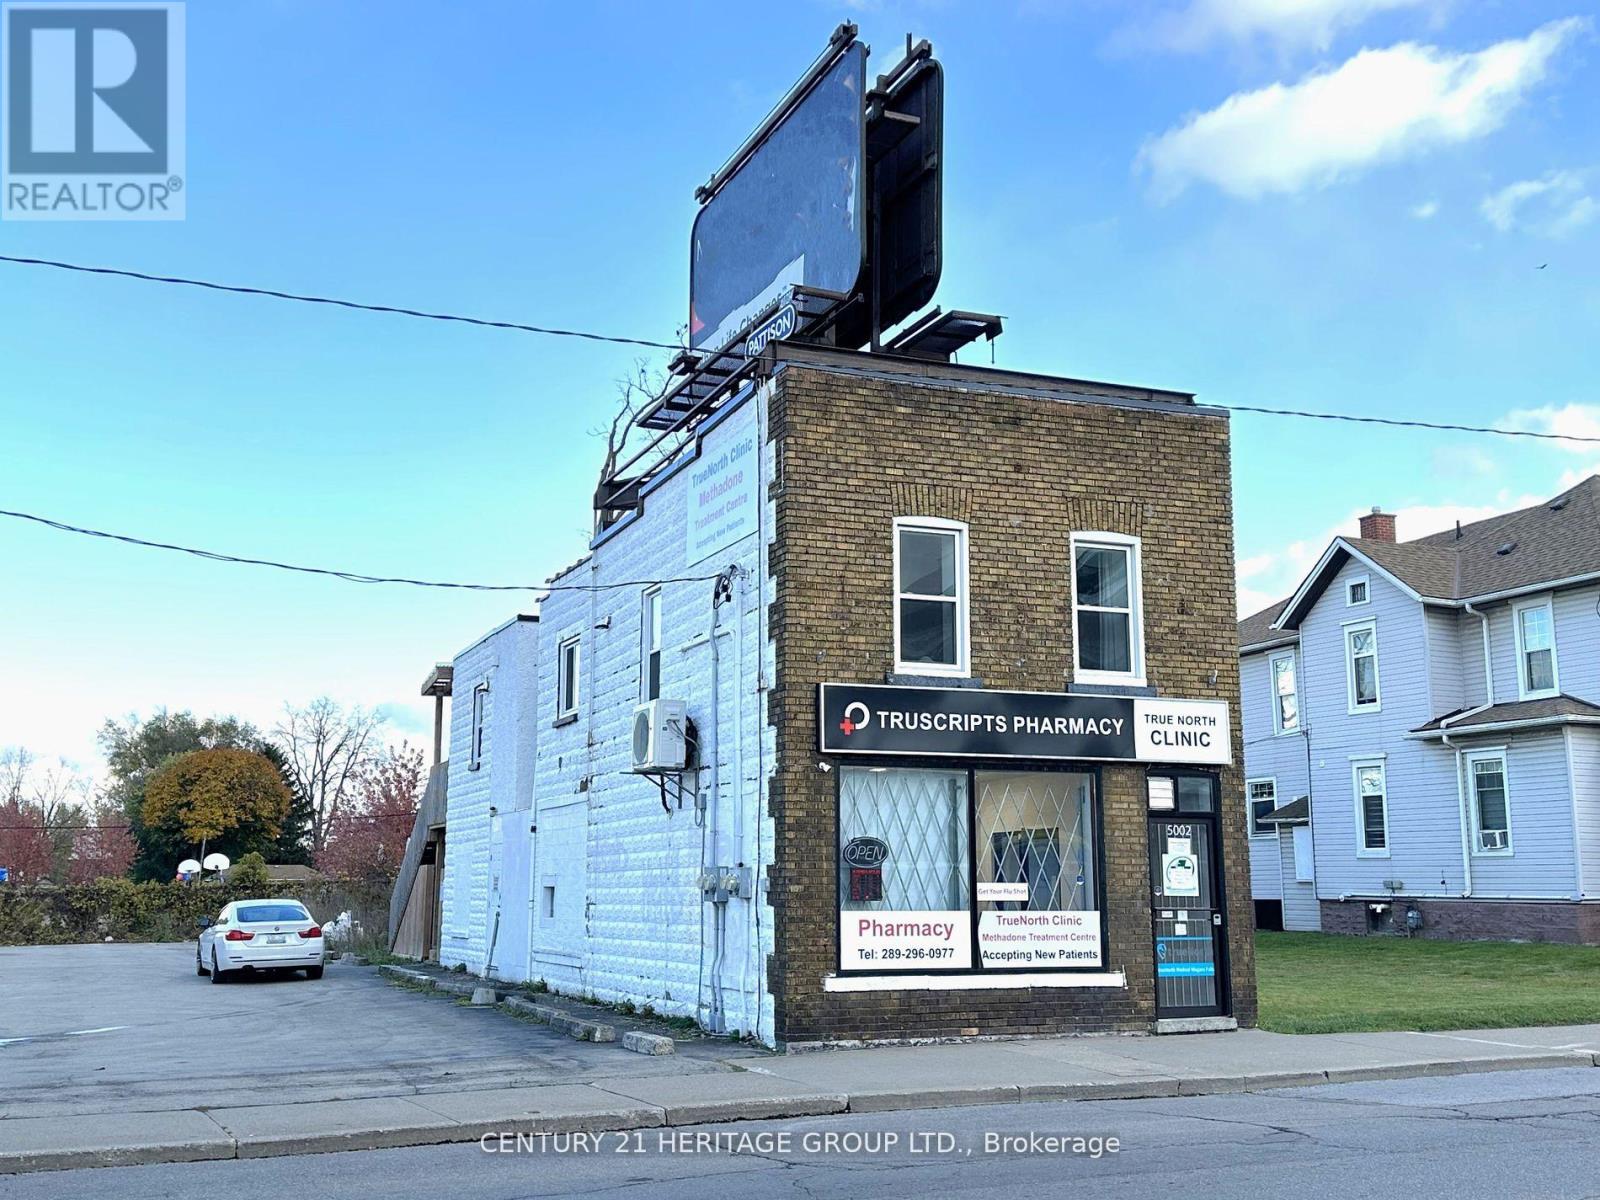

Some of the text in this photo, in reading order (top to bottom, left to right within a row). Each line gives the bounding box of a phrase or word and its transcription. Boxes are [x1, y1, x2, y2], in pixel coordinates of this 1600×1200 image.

[748, 311, 791, 357] PATTISON
[692, 438, 753, 488] TrueNorth Clinic
[699, 470, 743, 508] Methadone
[876, 711, 1124, 736] TRUSCRIPTS PHARMACY
[1144, 714, 1216, 727] TRUE NORTH
[1150, 730, 1211, 747] CLINIC
[1167, 825, 1192, 836] 5002
[847, 845, 884, 861] OPEN
[996, 915, 1082, 926] TrueNorth Clinic
[858, 919, 954, 941] Pharmacy
[982, 932, 1096, 942] Methadone Treatment Centre
[858, 948, 954, 960] Tel: 289-296-0977
[982, 949, 1098, 962] Accepting New Patients
